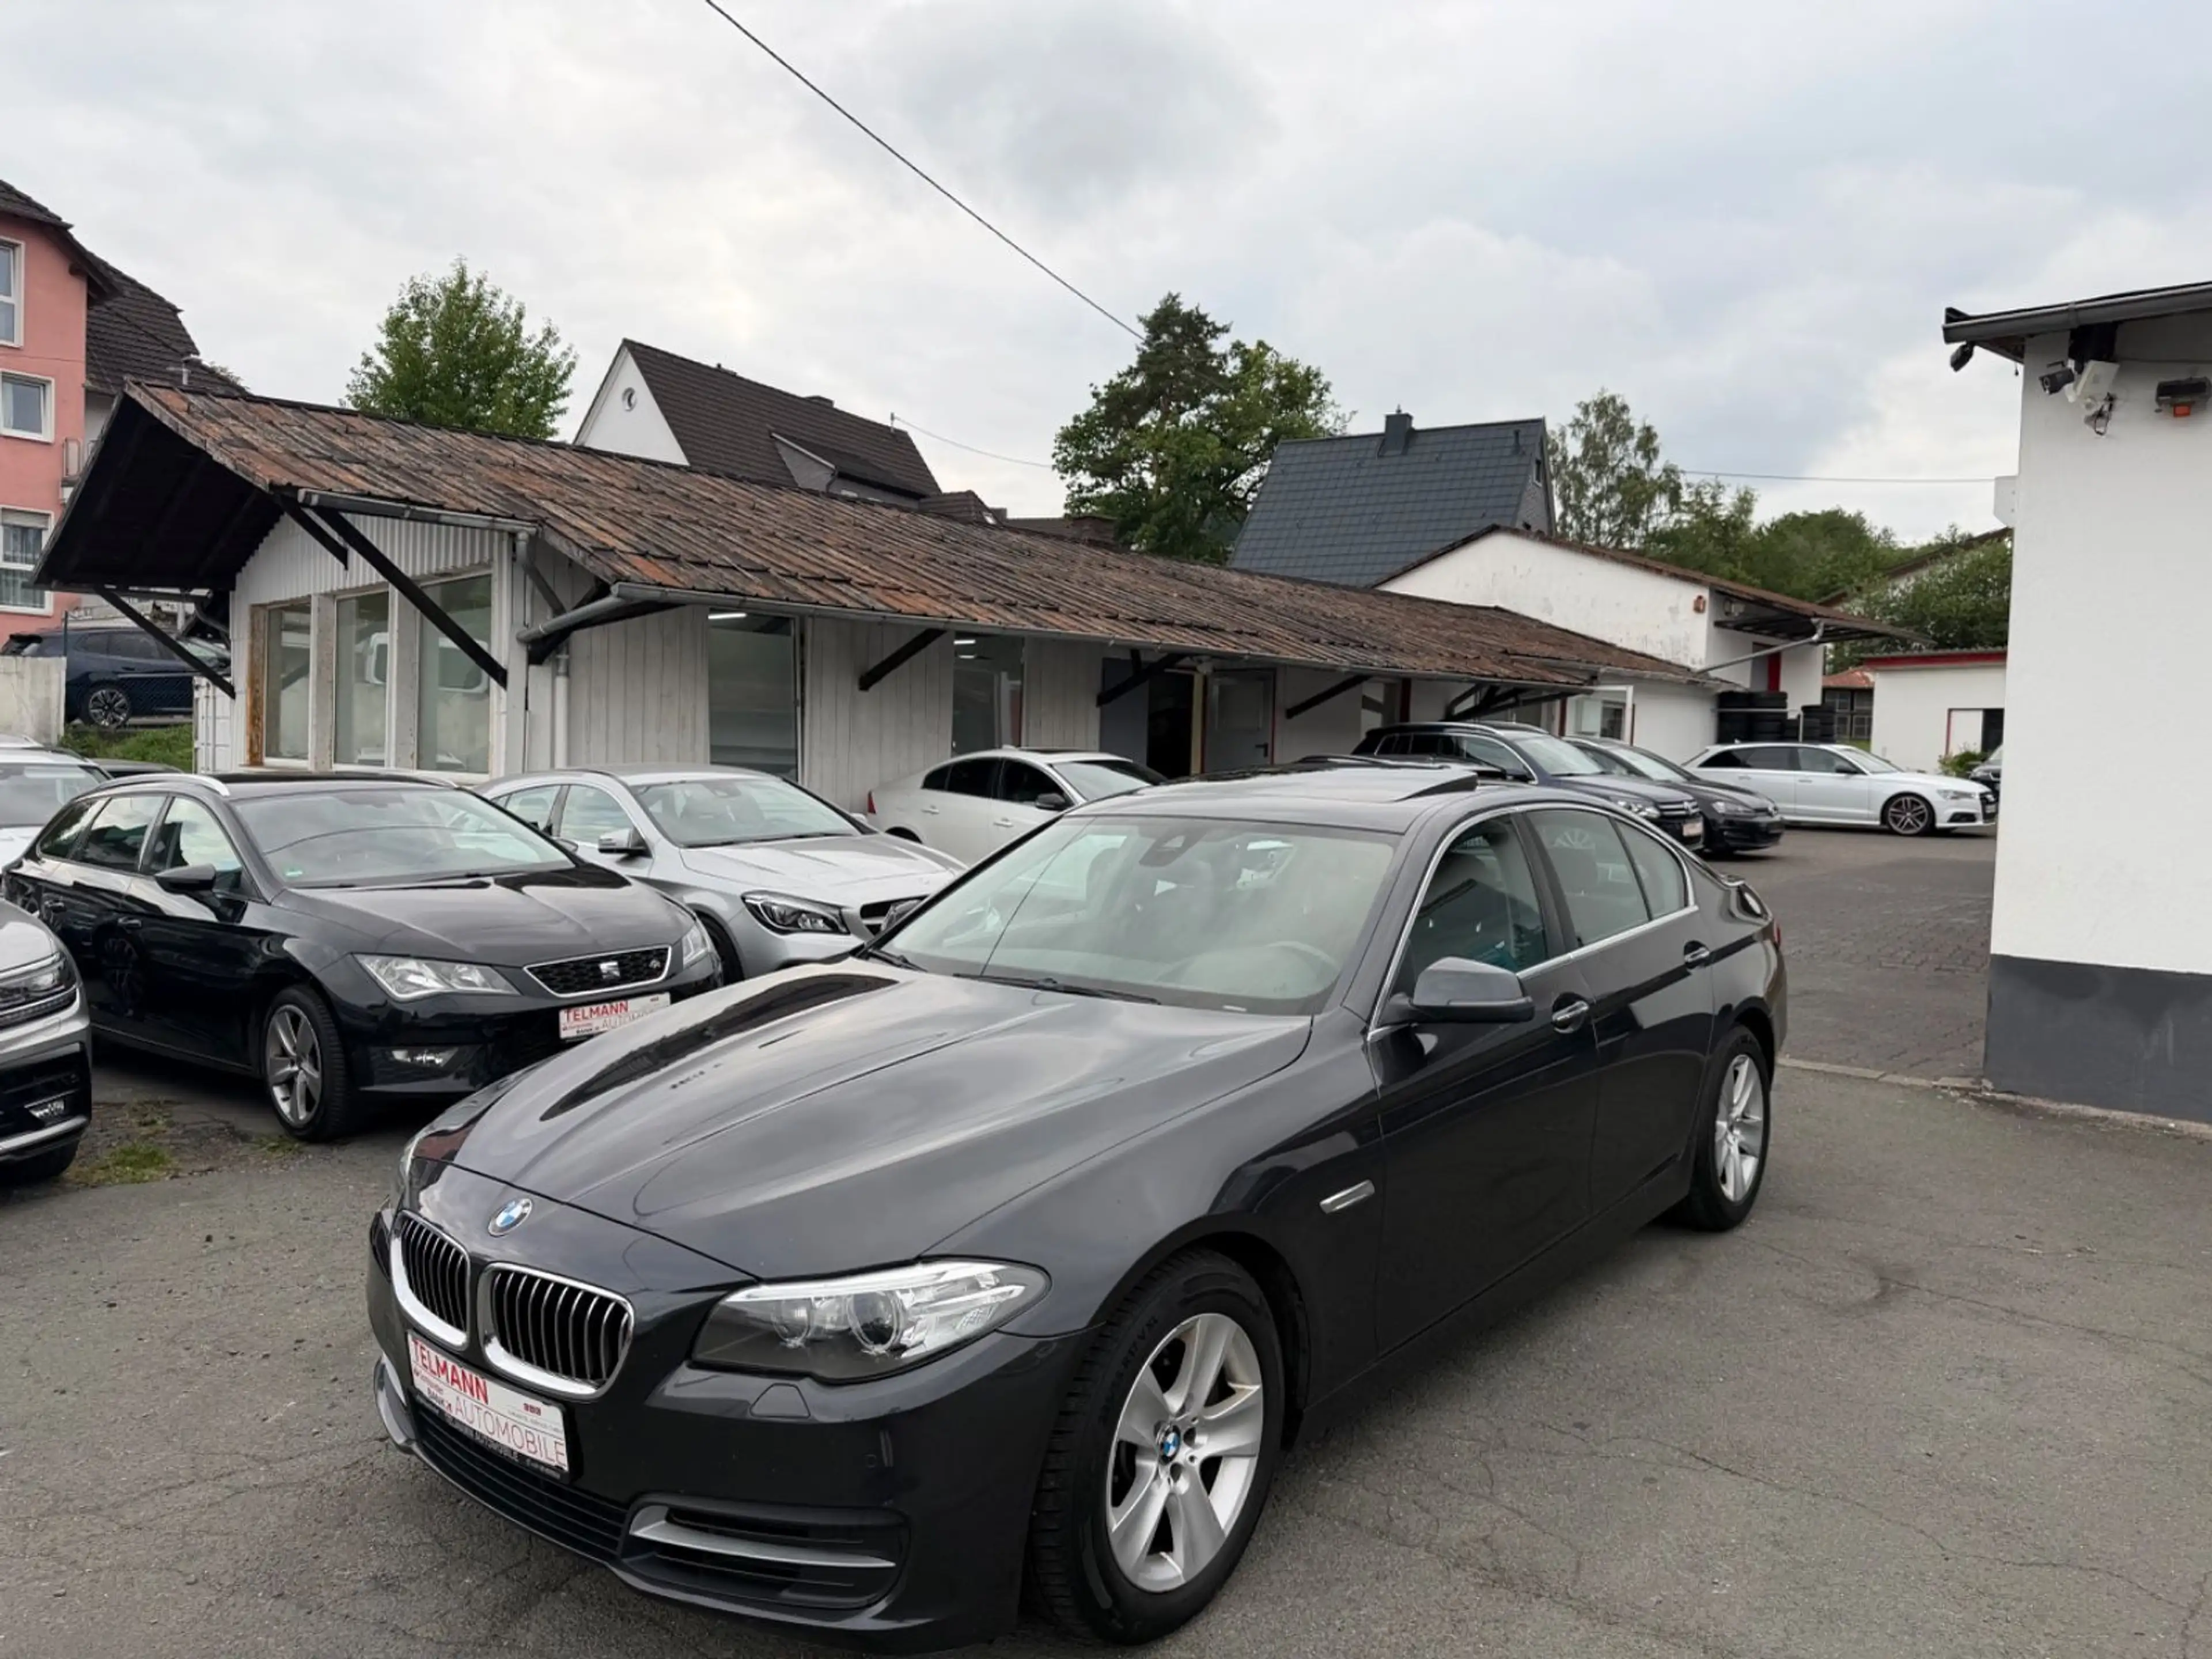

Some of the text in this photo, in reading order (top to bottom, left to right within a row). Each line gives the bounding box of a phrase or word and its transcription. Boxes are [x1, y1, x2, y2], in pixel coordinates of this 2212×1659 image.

[565, 1000, 628, 1022] TELMANN
[411, 1338, 489, 1406] TELMANN
[455, 1396, 567, 1467] AUTOMOBILE
